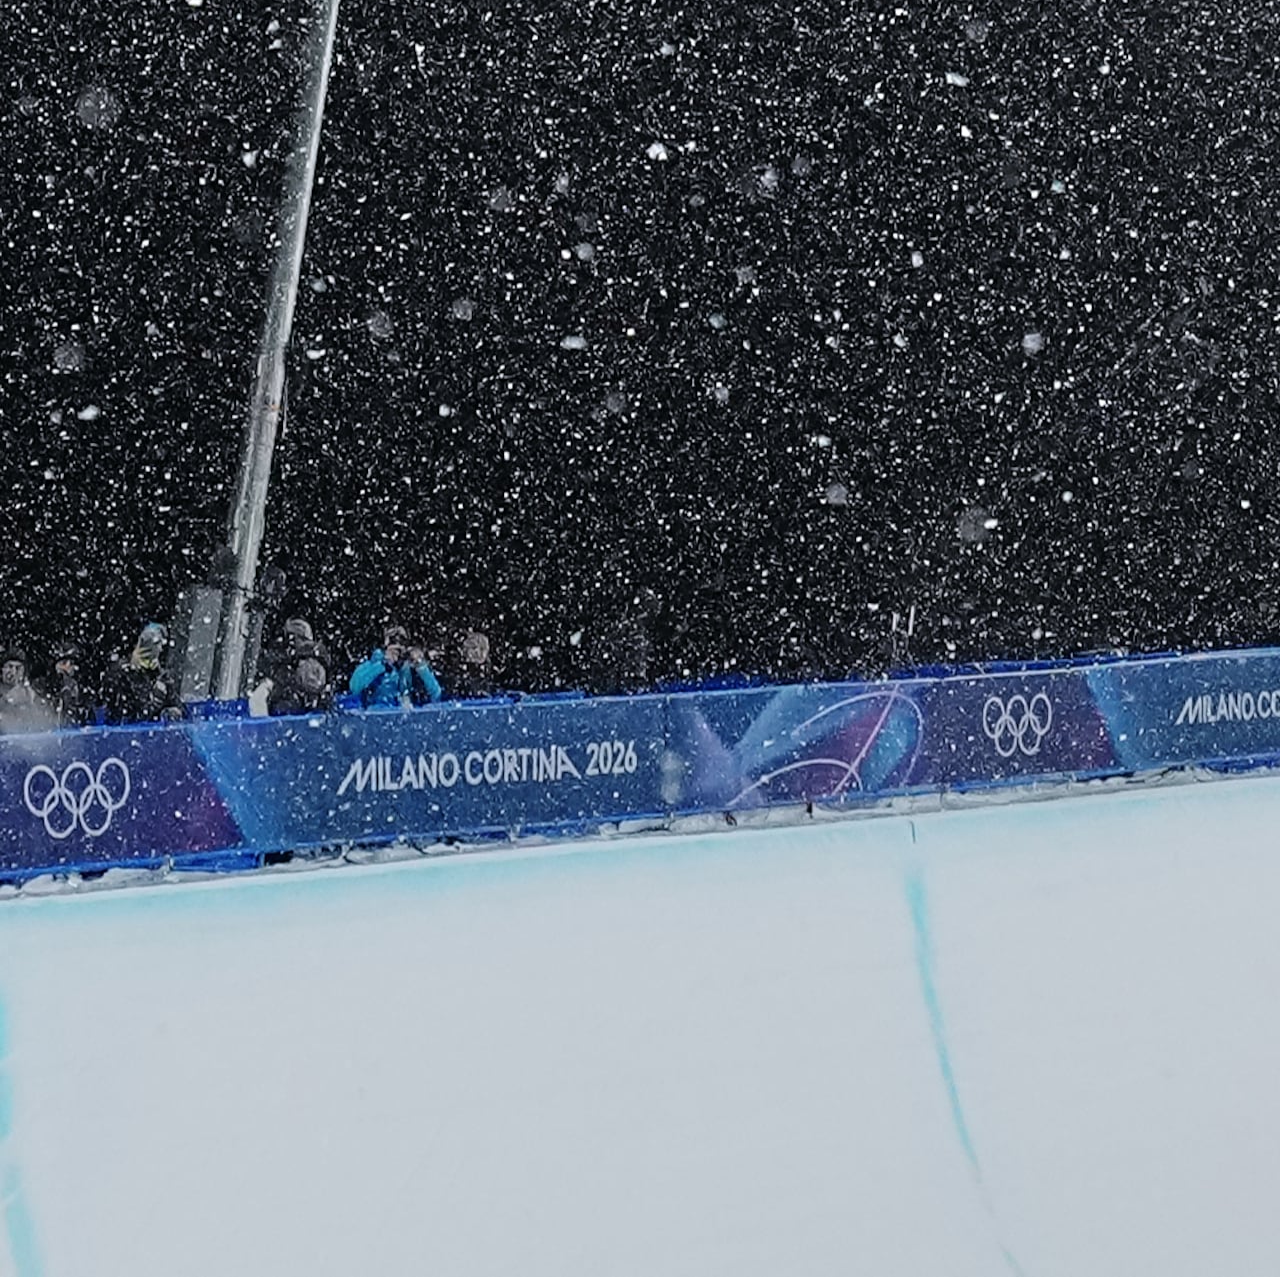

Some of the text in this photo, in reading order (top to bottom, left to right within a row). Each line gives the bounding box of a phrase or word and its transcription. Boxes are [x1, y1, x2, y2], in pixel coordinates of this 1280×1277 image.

[1175, 693, 1255, 725] MILANO
[336, 740, 638, 796] MILANO CORTINA 2026
